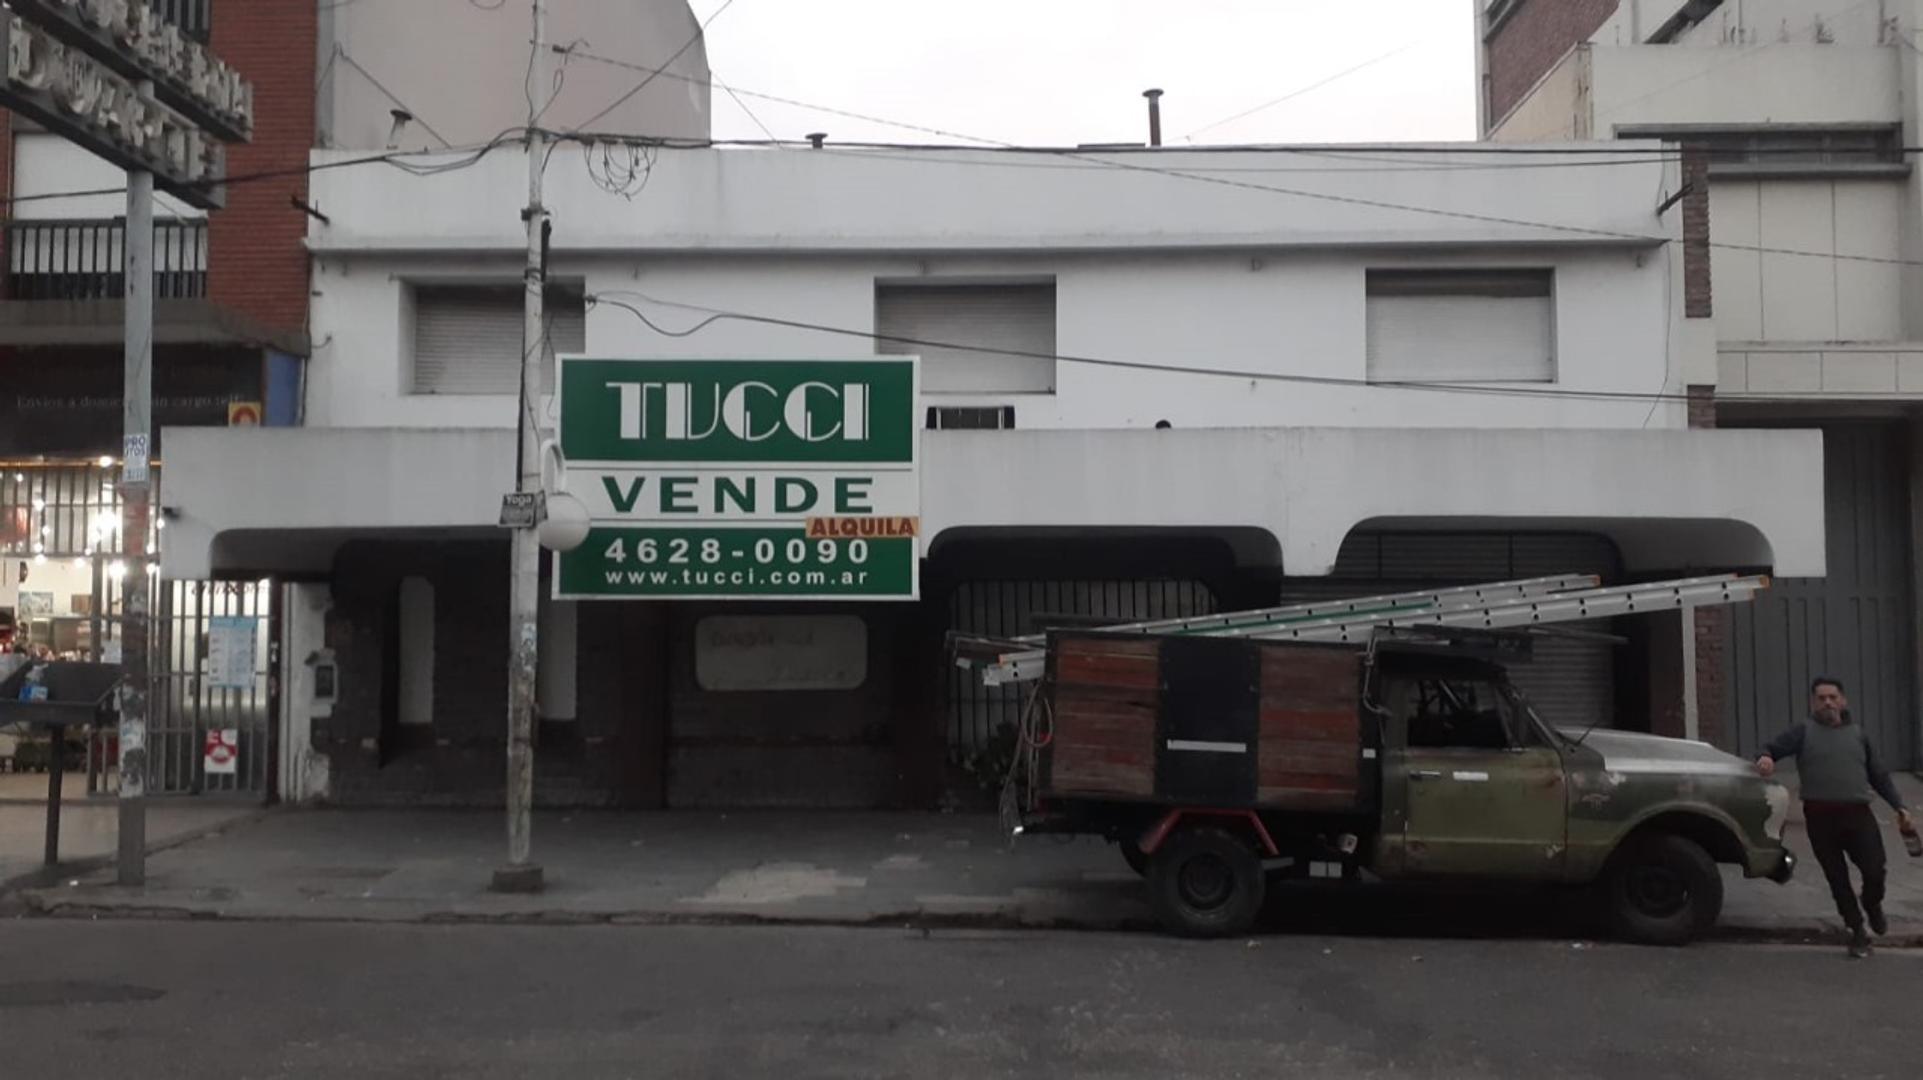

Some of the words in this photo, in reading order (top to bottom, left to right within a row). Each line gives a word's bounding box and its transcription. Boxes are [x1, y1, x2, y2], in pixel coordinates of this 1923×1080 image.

[605, 381, 870, 442] TUCCI
[601, 476, 874, 514] VENDE
[810, 517, 915, 536] ALQUILA
[604, 538, 869, 564] 4628-0090
[605, 568, 868, 585] www.tucci.com.ar
